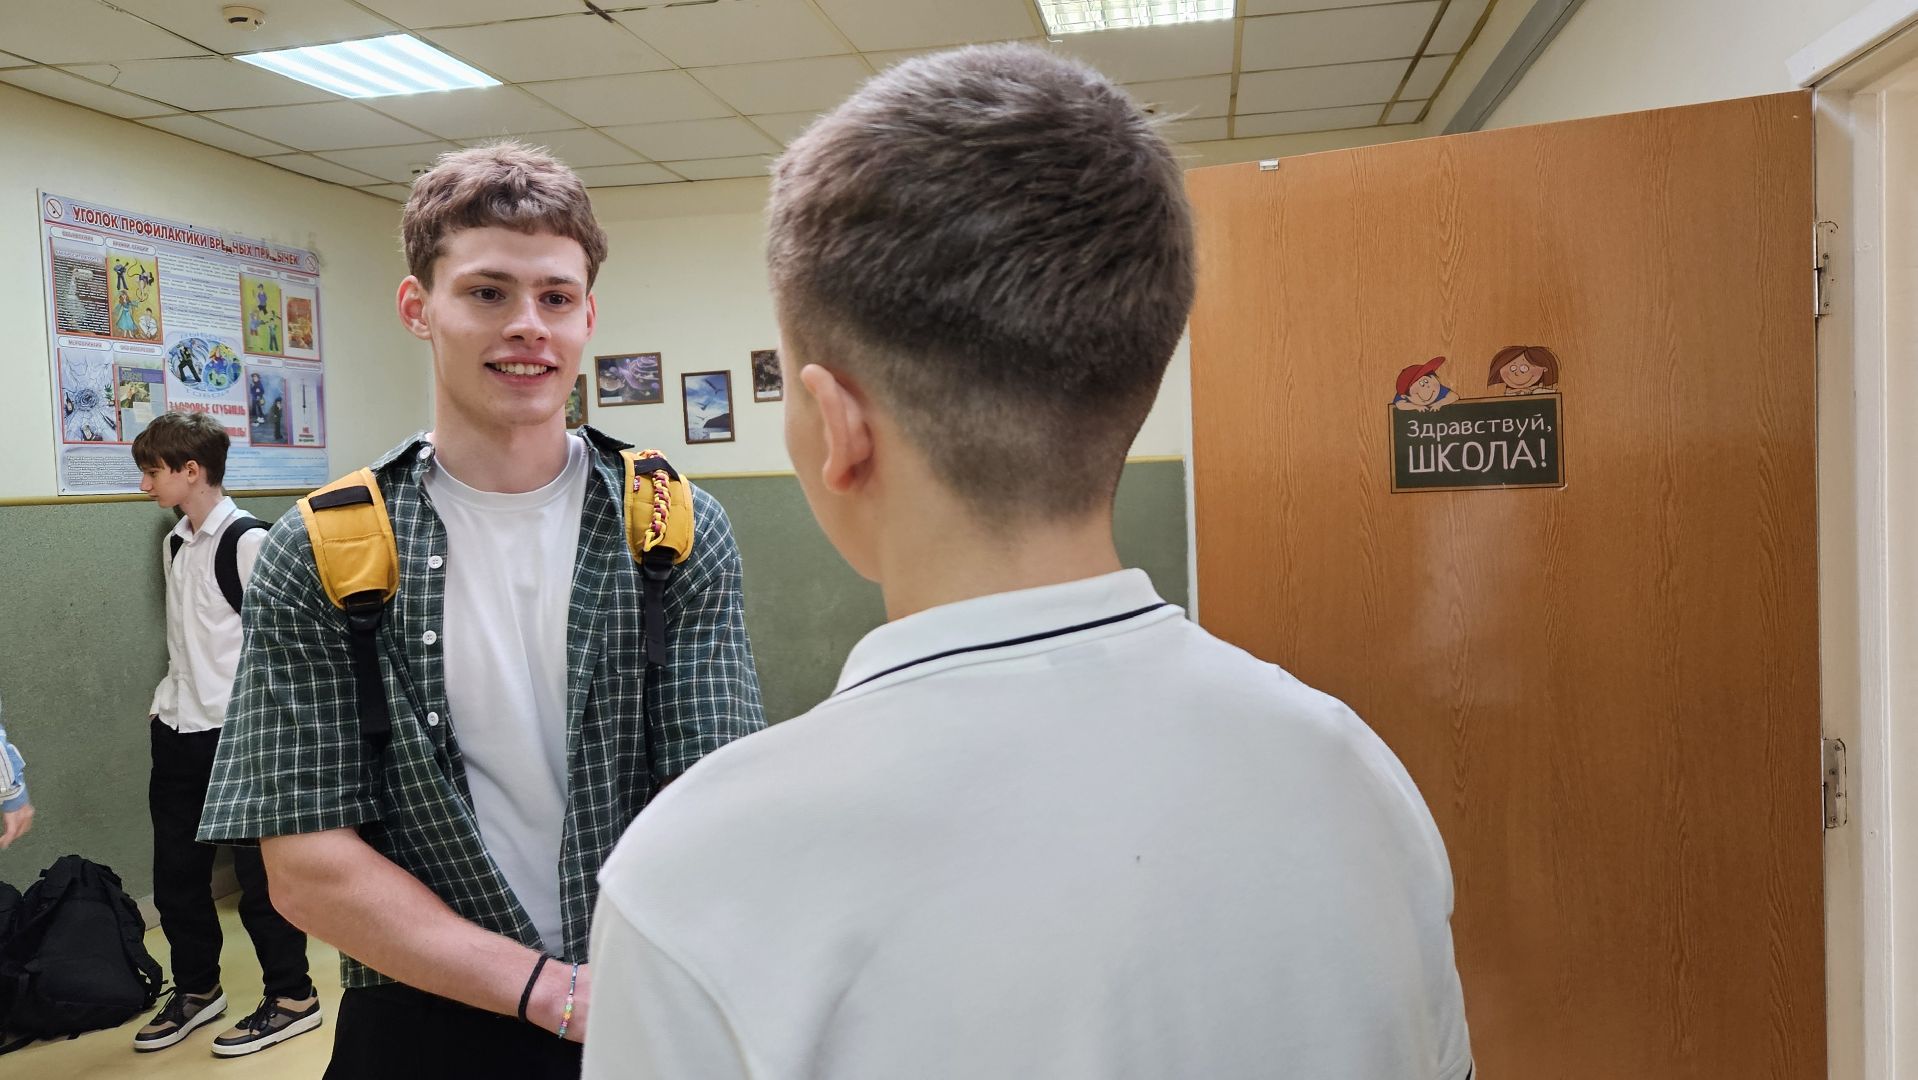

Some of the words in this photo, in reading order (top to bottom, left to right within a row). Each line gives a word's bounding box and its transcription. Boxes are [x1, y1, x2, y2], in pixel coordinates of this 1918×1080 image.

[72, 206, 119, 229] УГОЛОК
[121, 217, 207, 247] ПРОФИЛАКТИКИ
[1406, 413, 1552, 441] Здравствуй,
[1408, 438, 1547, 474] ШКОЛА!
